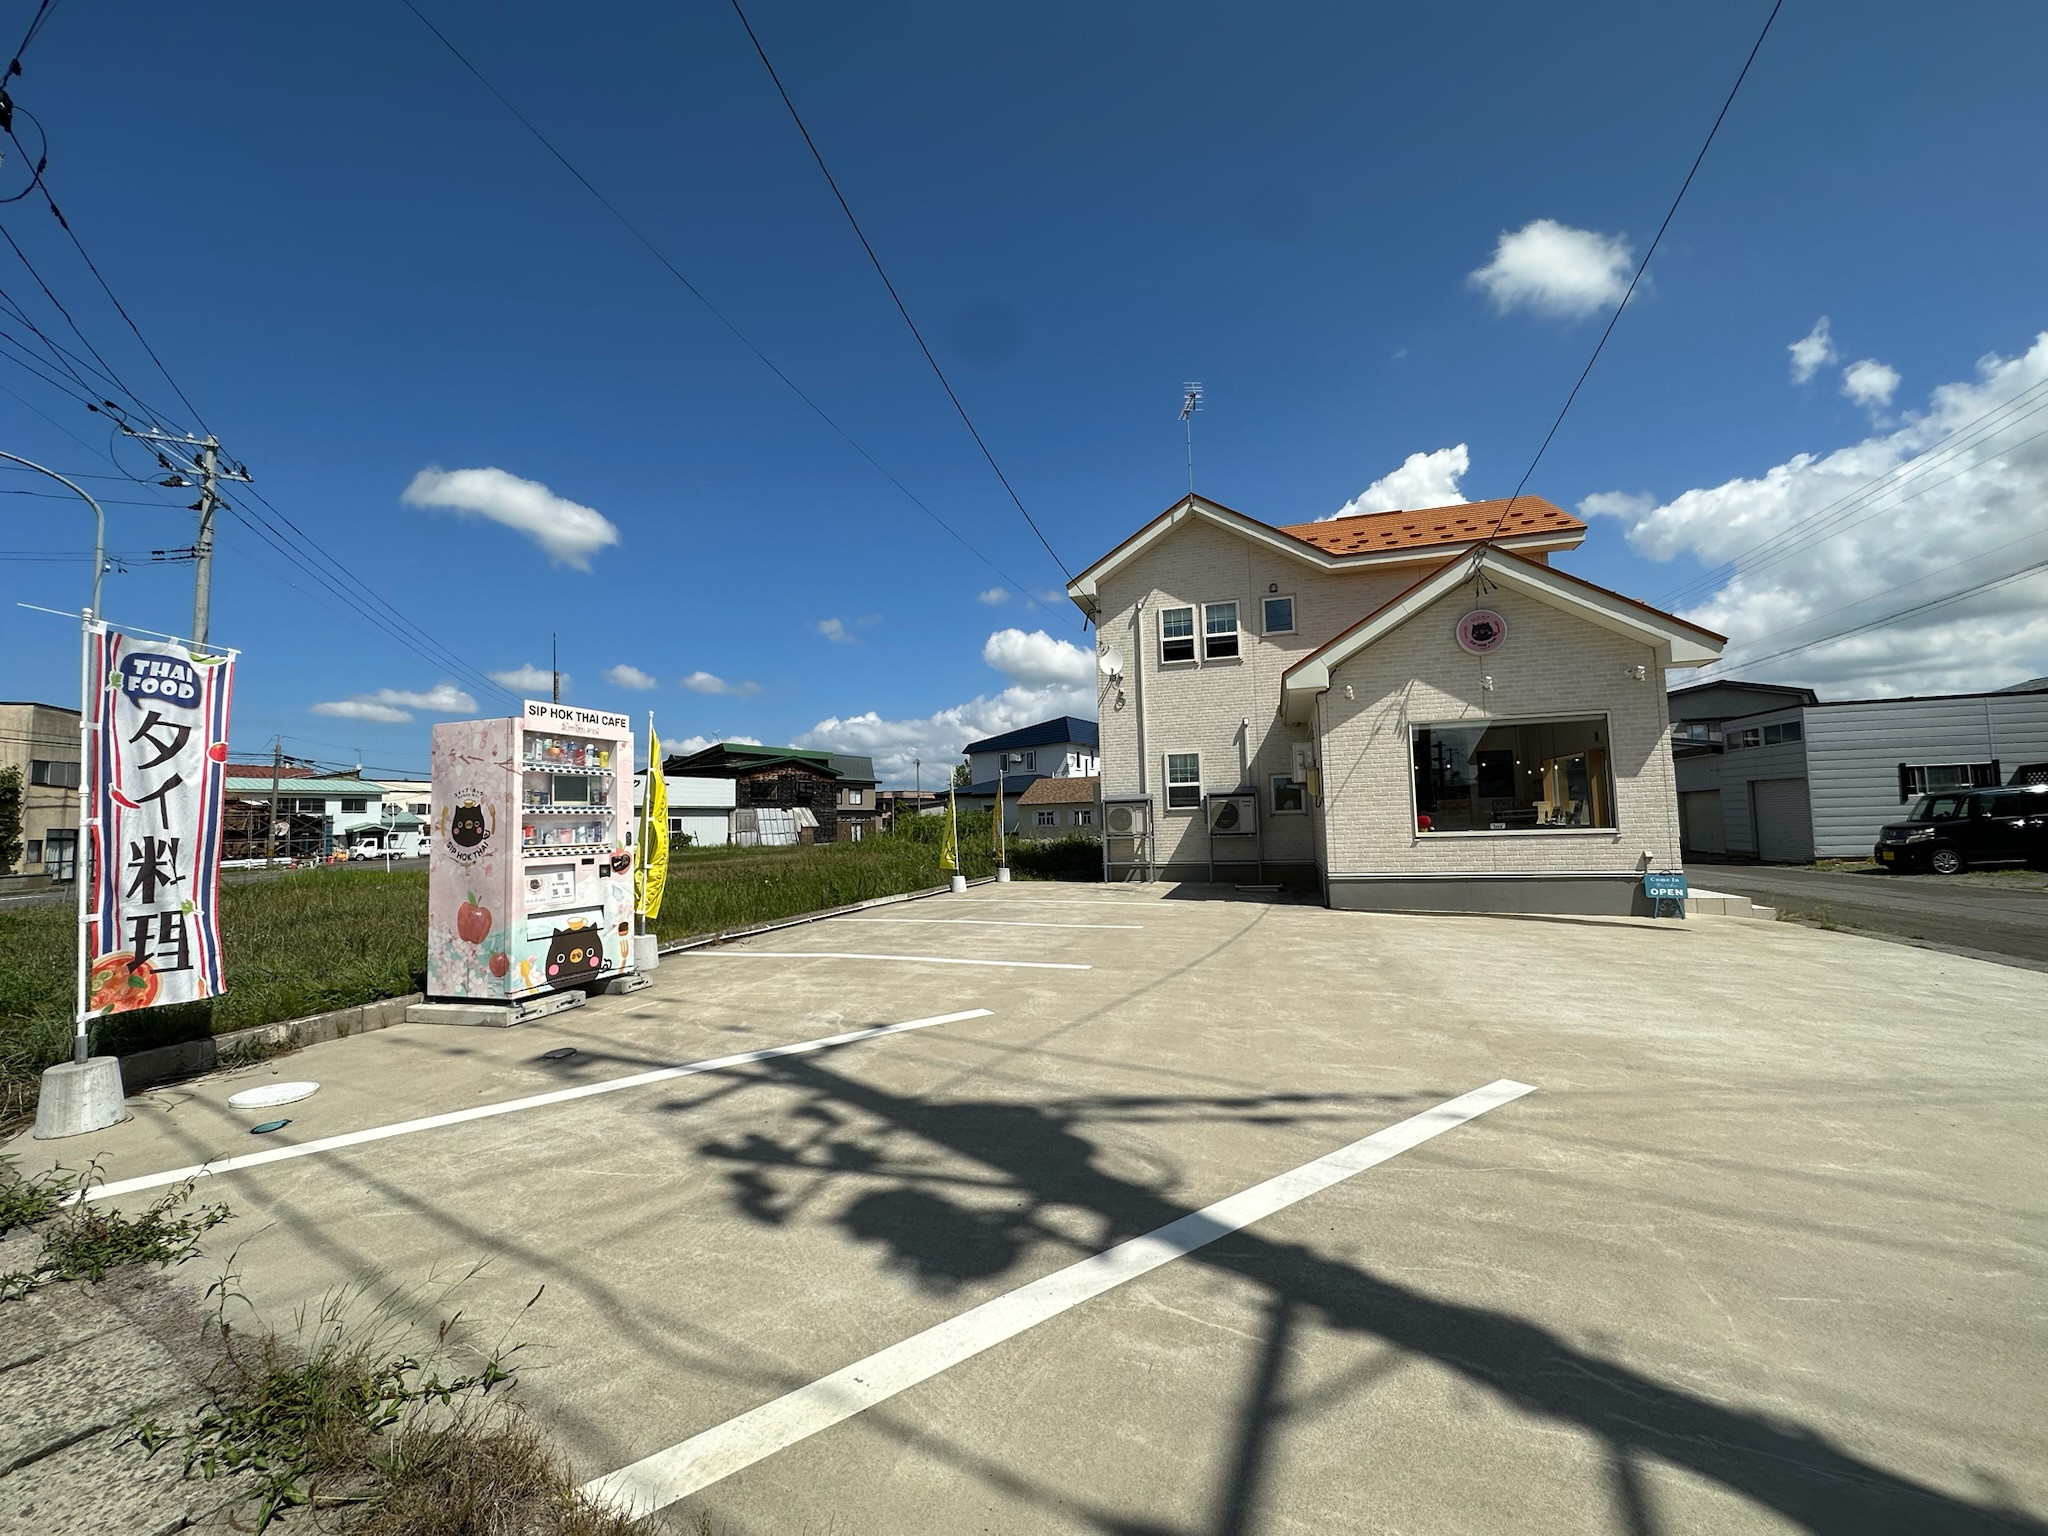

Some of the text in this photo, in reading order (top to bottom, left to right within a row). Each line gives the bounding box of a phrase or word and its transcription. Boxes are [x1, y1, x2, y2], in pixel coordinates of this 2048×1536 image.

[134, 658, 193, 683] THAI
[128, 674, 195, 700] FOOD
[528, 705, 547, 717] SIP
[550, 707, 574, 721] HOK
[575, 711, 599, 725] THAI
[601, 716, 627, 728] CAFE
[127, 711, 193, 974] タイ料理
[447, 841, 489, 861] SIP HOK THAI
[1650, 888, 1684, 896] OPEN
